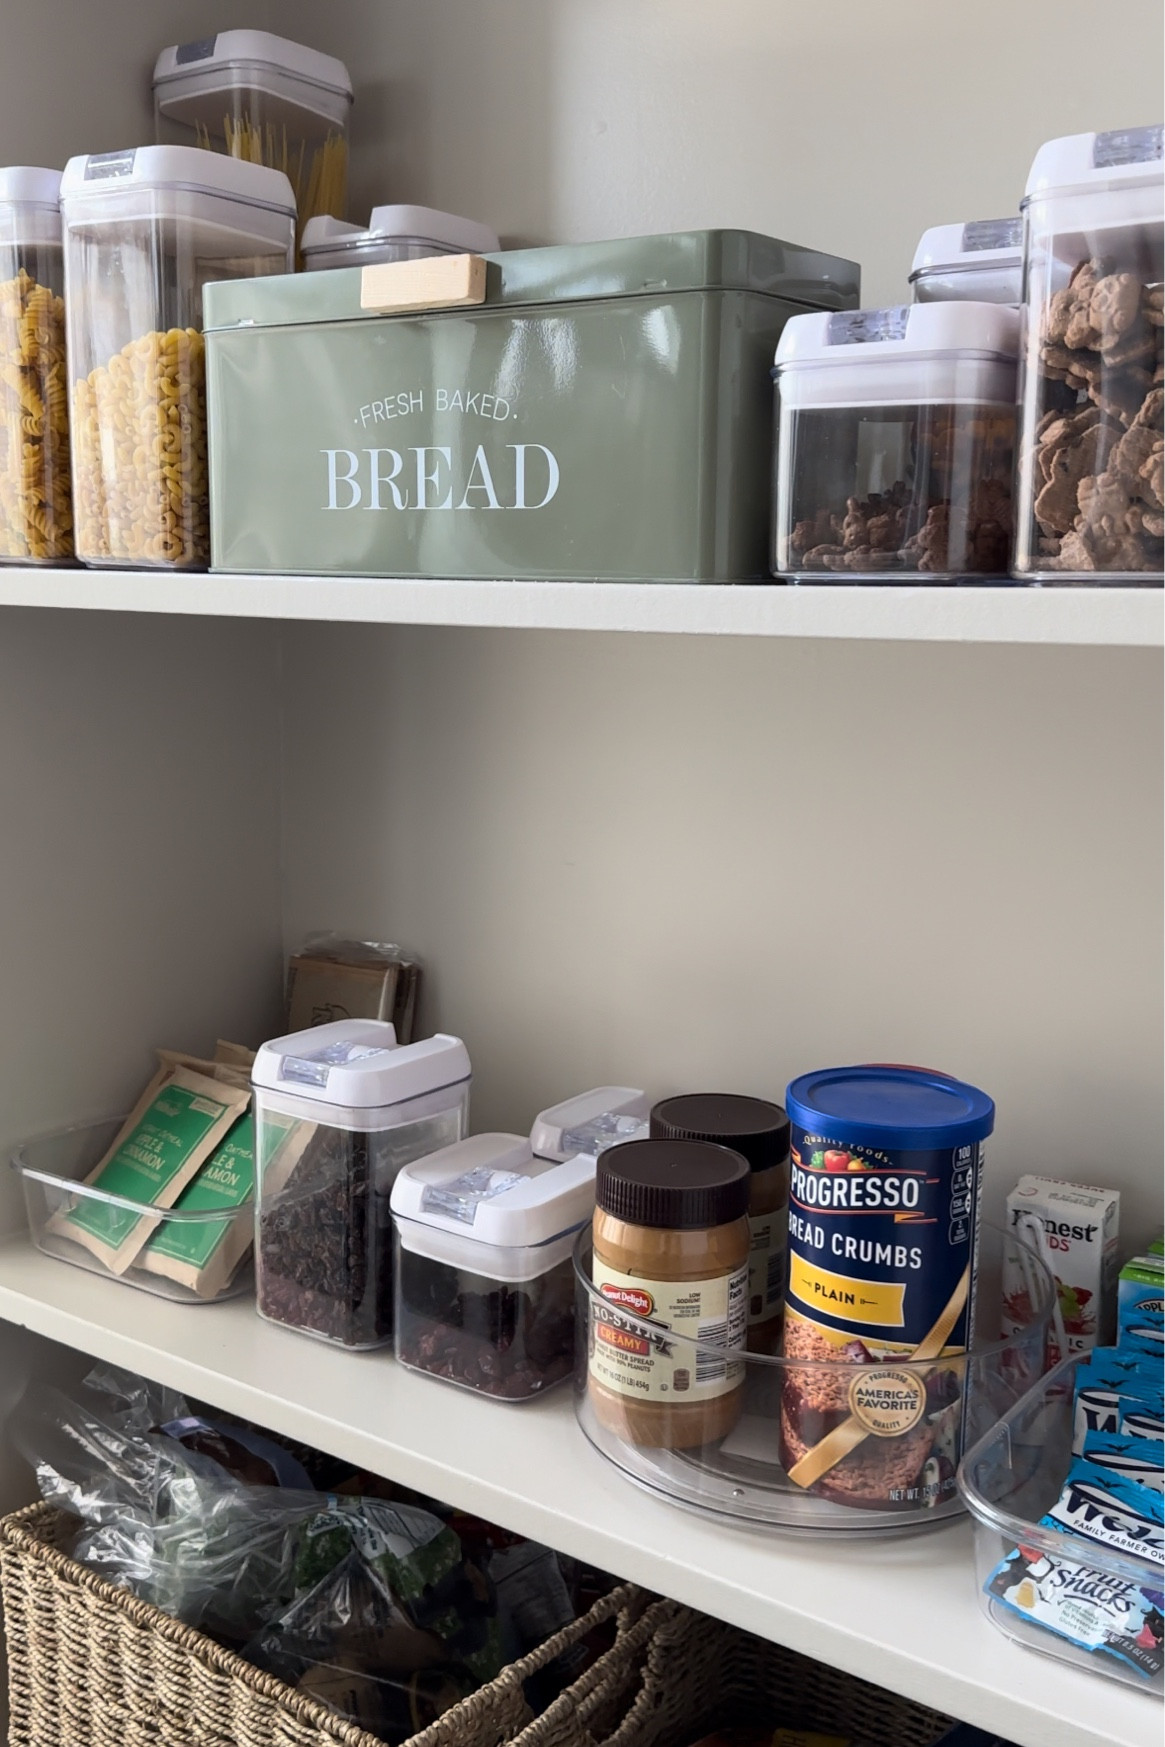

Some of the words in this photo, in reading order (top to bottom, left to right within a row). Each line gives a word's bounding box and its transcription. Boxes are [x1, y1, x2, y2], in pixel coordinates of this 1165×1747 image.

[359, 389, 423, 428] FRESH
[436, 389, 510, 421] BAKED
[319, 444, 560, 510] BREAD
[225, 1157, 235, 1169] &
[204, 1167, 240, 1185] AMON
[791, 1164, 919, 1208] PROGRESSO
[1011, 1208, 1098, 1242] Hnest
[831, 1233, 922, 1270] CRUMBS
[622, 1291, 648, 1308] Delight
[814, 1282, 855, 1306] PLAIN
[600, 1327, 642, 1351] CREAMY
[629, 1356, 654, 1367] SPREAD
[857, 1397, 917, 1411] FAVORITE
[873, 1419, 900, 1430] QUALITY
[889, 1489, 904, 1501] NET
[1073, 1519, 1106, 1537] FAMILY
[1109, 1535, 1147, 1553] FARMER
[1049, 1569, 1136, 1613] Snacks
